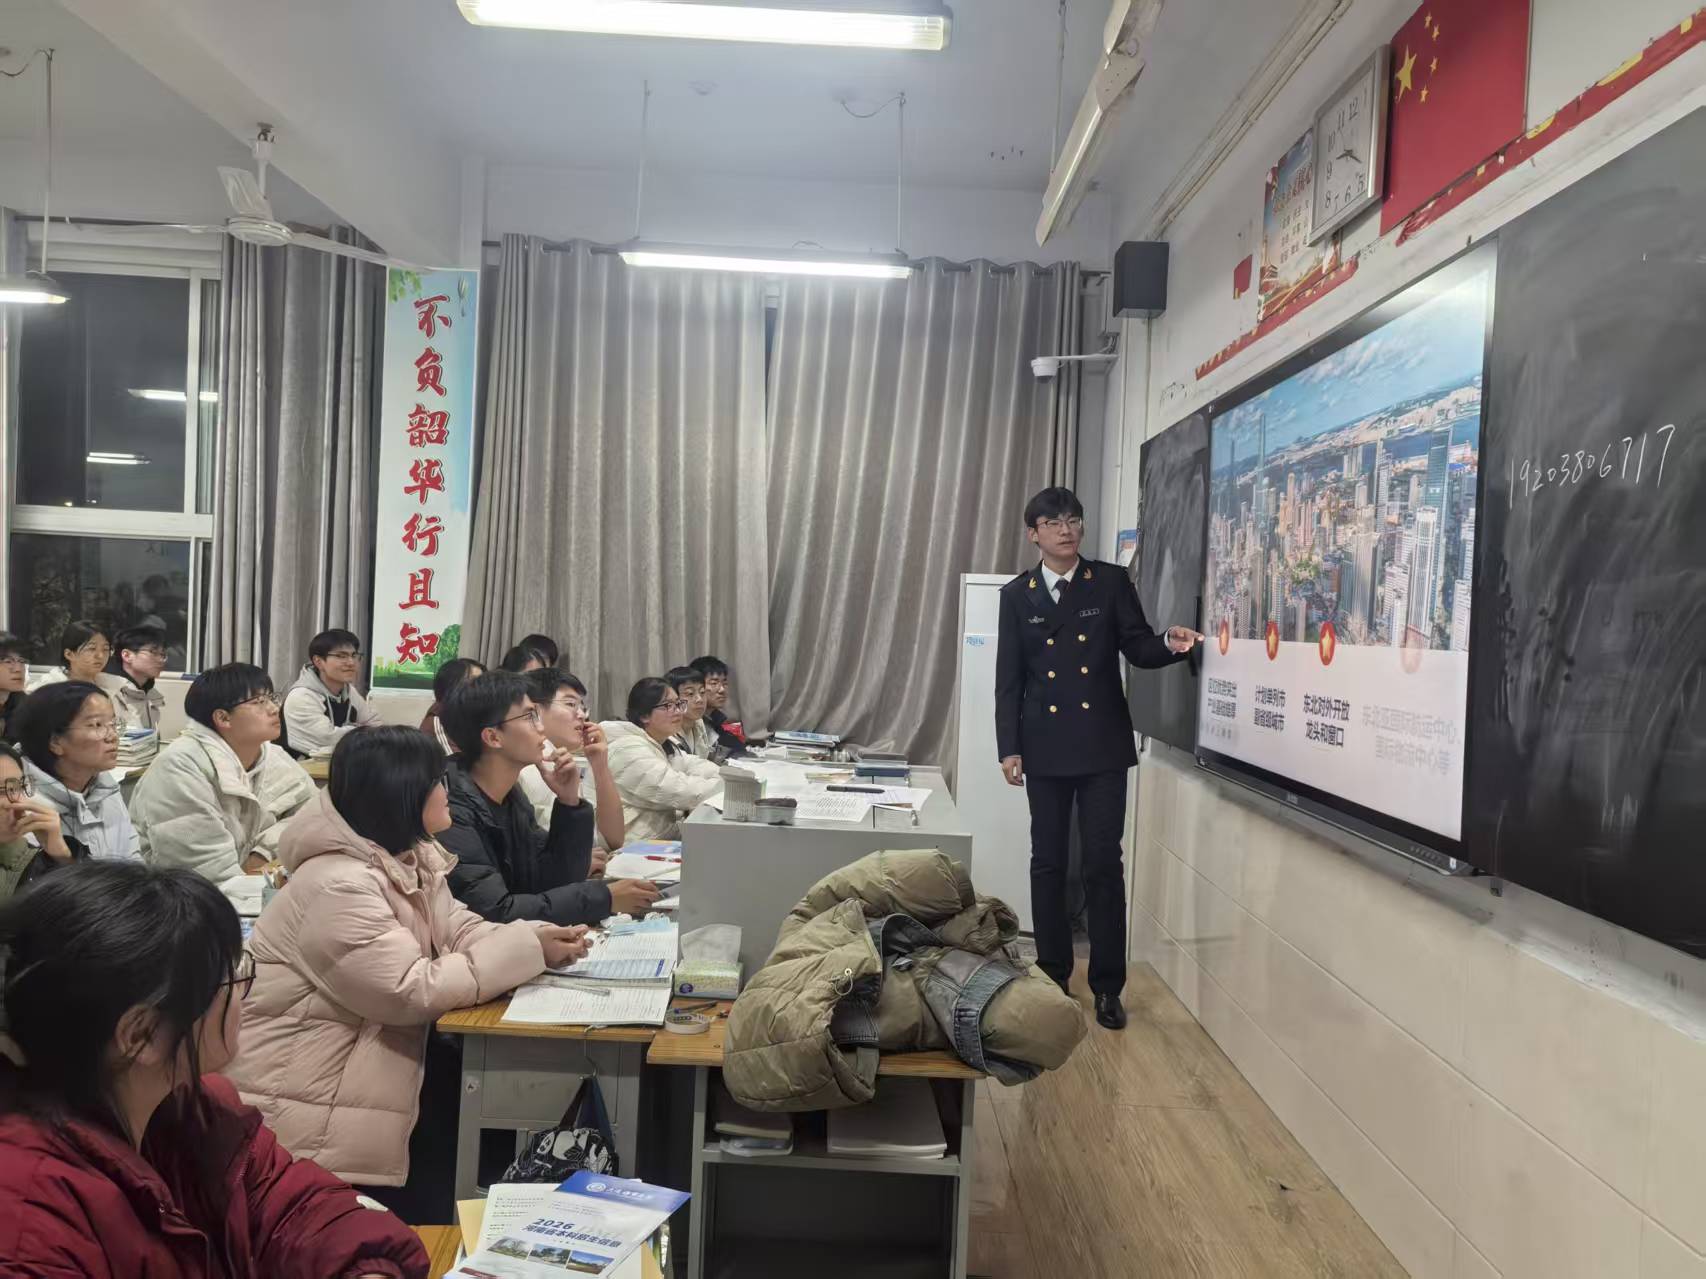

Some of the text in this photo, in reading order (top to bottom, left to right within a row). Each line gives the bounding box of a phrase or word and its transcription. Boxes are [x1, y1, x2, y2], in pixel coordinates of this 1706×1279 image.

[1337, 110, 1345, 130] 11
[1349, 97, 1358, 121] 12
[1327, 130, 1336, 152] 10
[1326, 160, 1333, 183] 9
[1357, 174, 1365, 193] 5
[1325, 190, 1332, 209] 8
[1344, 184, 1352, 203] 6
[1509, 423, 1676, 511] 19203806717
[395, 294, 452, 667] 不负韶华行且知
[1254, 684, 1287, 708] 计划单列市
[1303, 691, 1351, 722] 东北对外开放
[1253, 707, 1286, 732] 副省级城市
[1305, 719, 1345, 748] 龙头和窗口
[521, 1224, 622, 1248] 河南省本科招生信息
[533, 1218, 575, 1230] 2026
